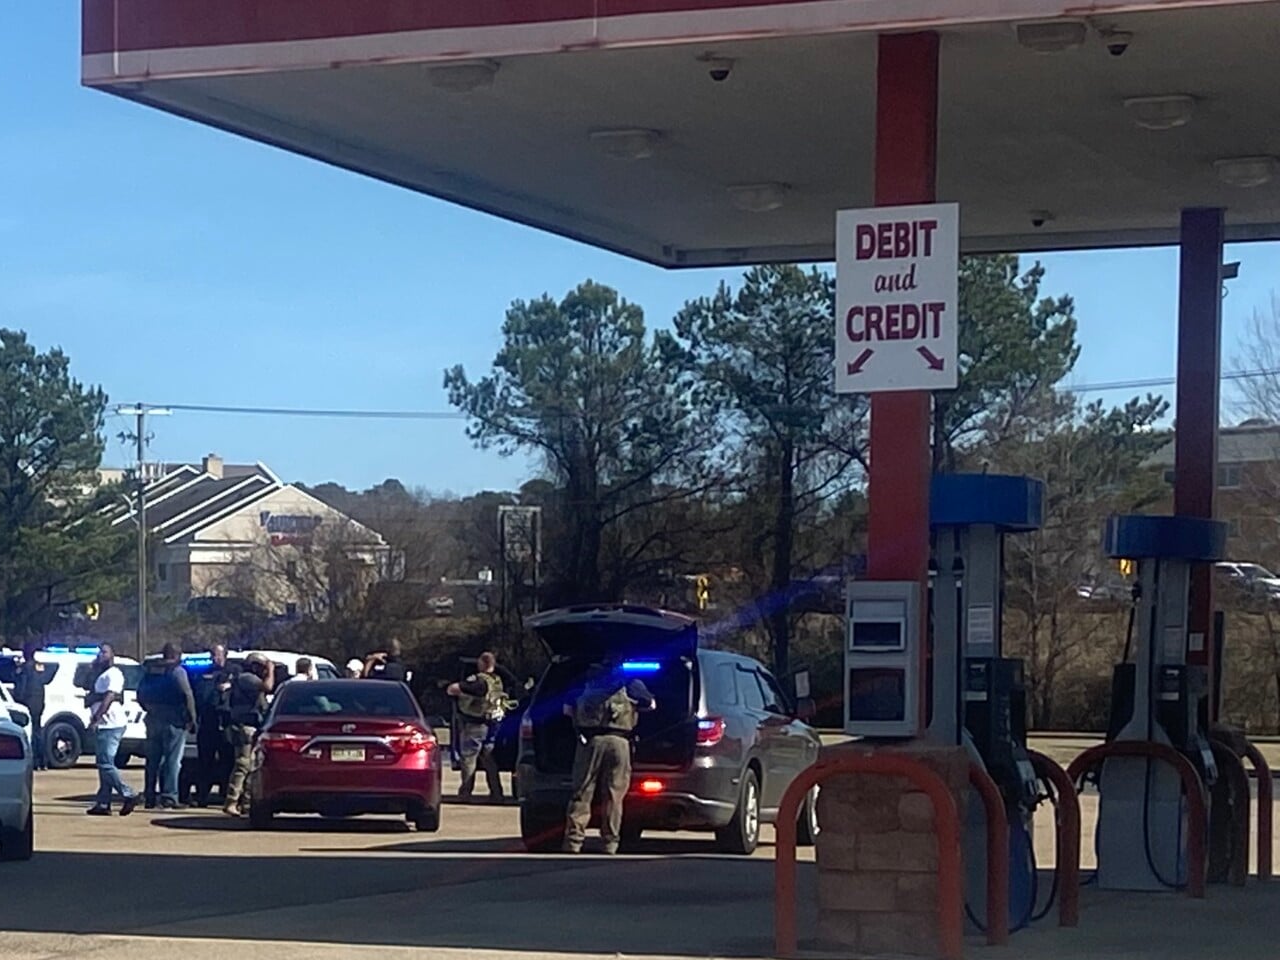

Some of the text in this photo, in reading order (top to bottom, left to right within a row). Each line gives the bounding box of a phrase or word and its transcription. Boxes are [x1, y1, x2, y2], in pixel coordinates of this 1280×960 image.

[856, 220, 937, 260] DEBIT
[874, 263, 918, 293] and
[846, 302, 946, 343] CREDIT
